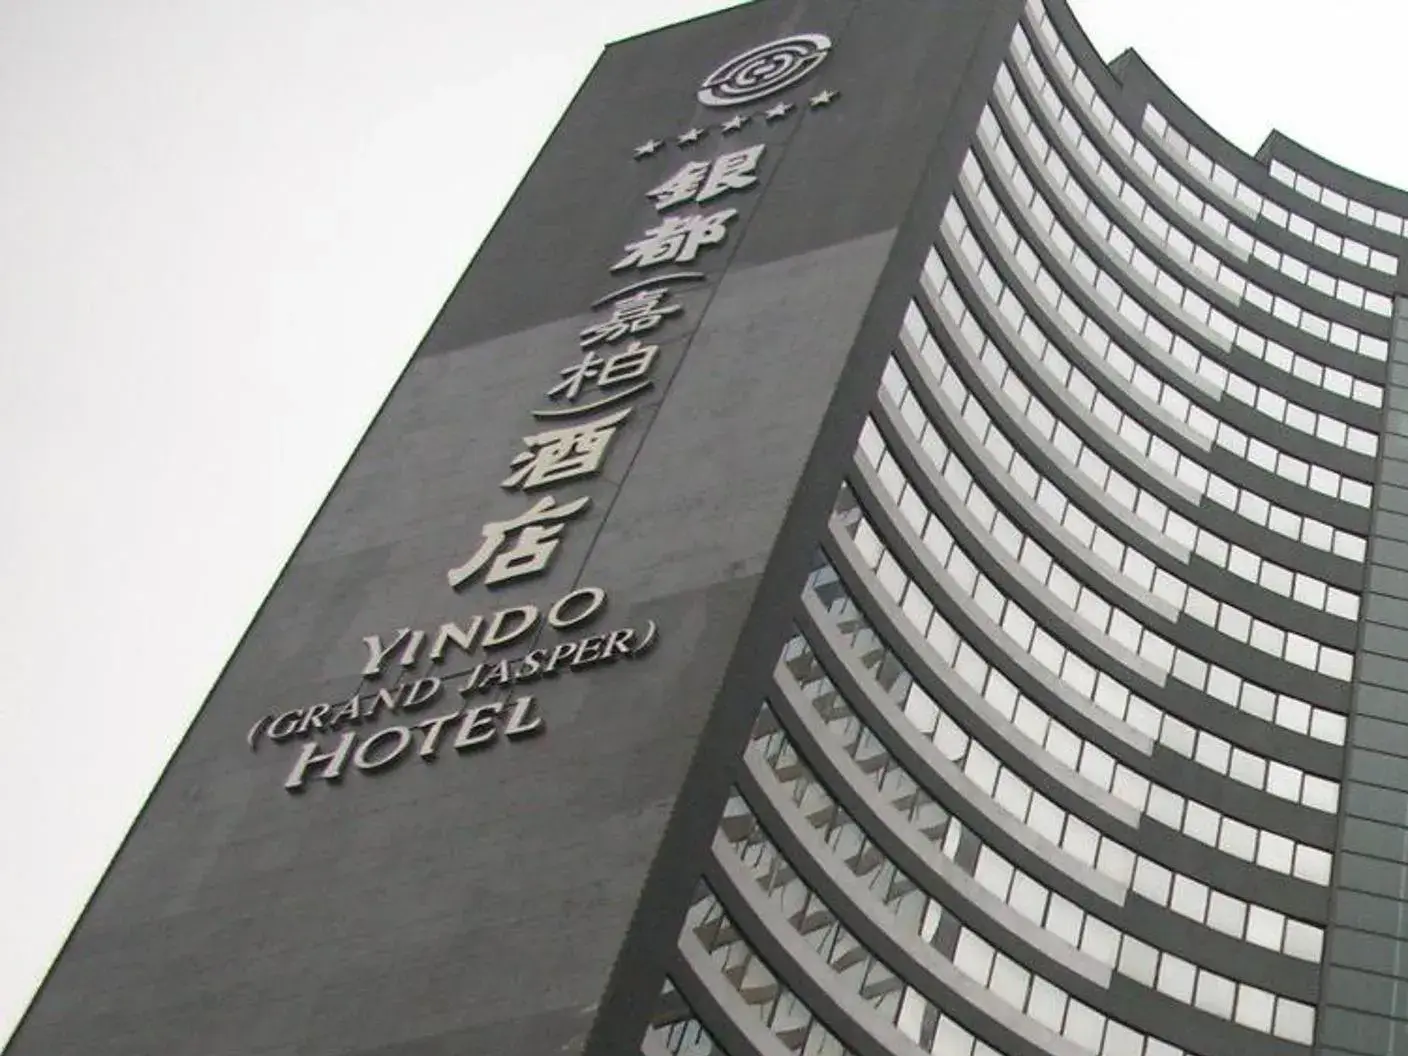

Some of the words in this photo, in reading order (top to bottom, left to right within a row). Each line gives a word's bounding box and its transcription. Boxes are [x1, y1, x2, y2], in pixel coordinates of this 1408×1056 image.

[361, 586, 607, 676] YINDO
[247, 676, 441, 749] (GRAND
[459, 619, 659, 698] JASPER)
[284, 695, 545, 790] HOTEL
